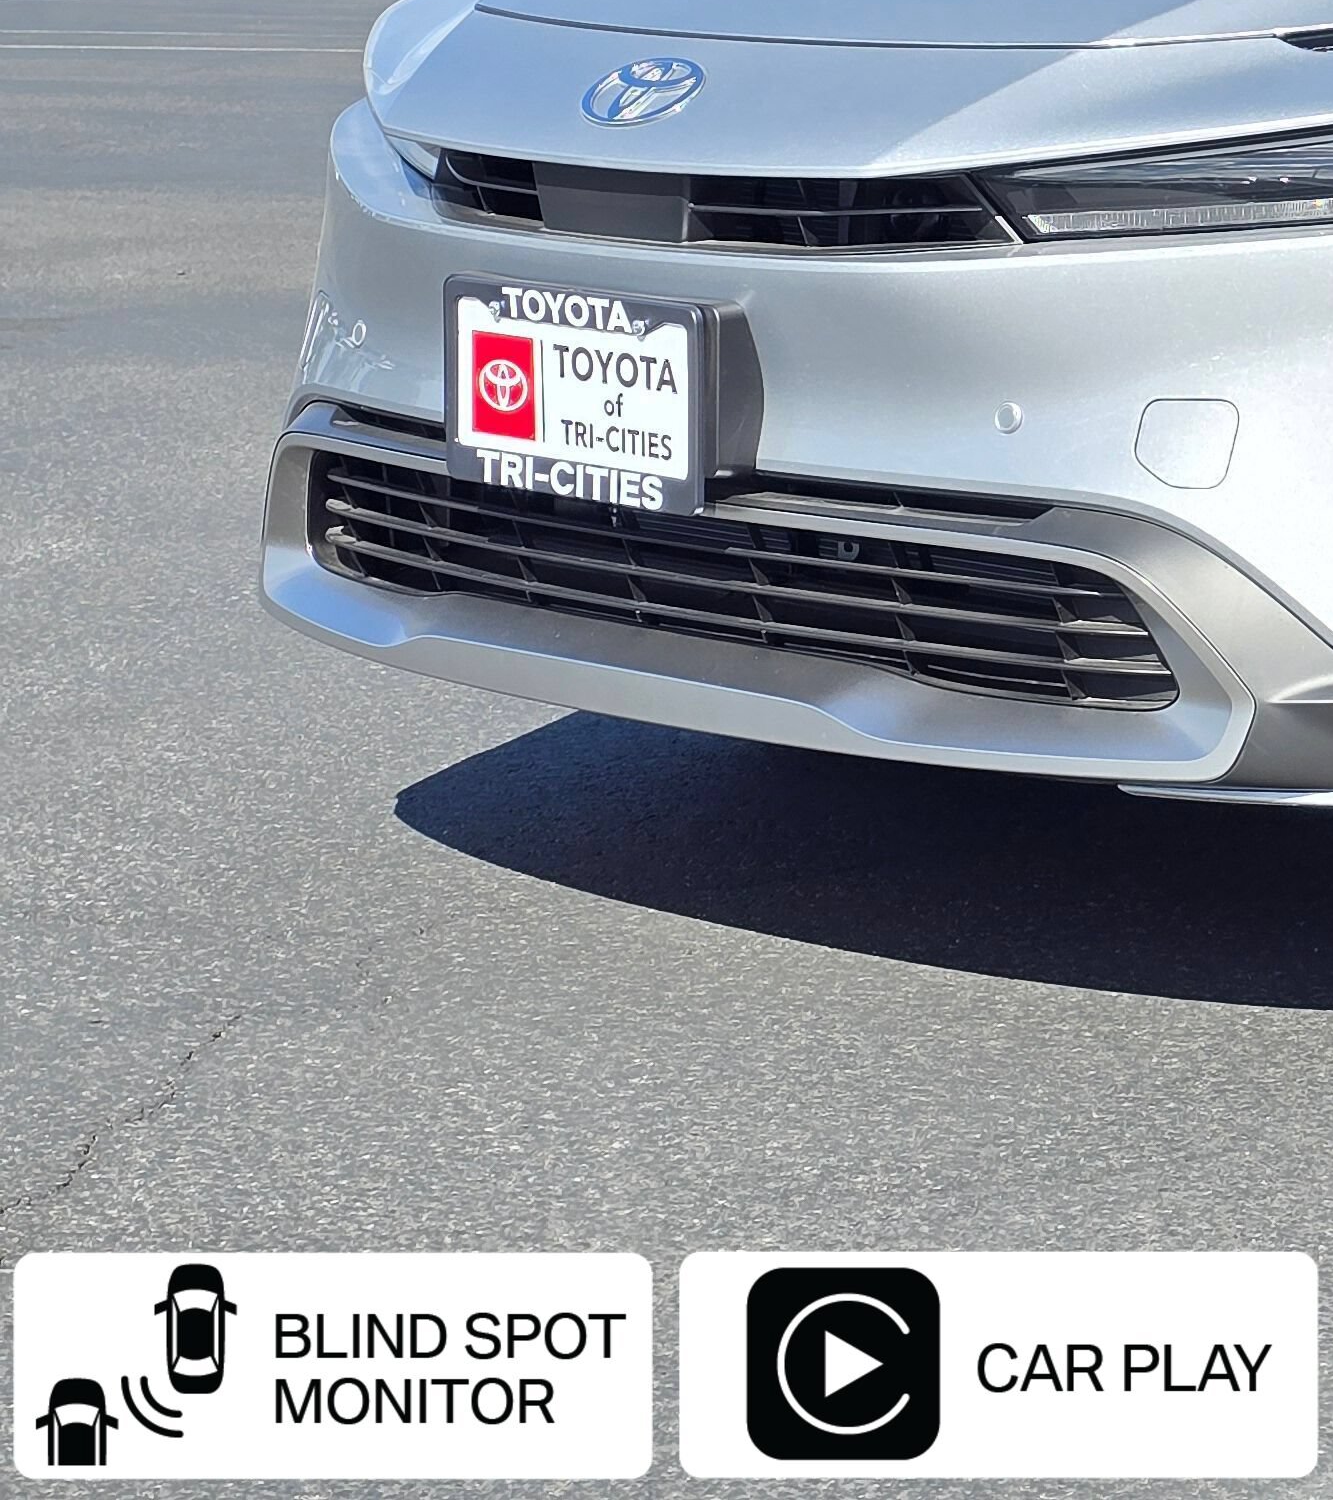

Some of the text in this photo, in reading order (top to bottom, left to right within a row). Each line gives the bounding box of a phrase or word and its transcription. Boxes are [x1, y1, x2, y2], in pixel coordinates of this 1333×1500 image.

[501, 286, 633, 334] TOYOTA
[553, 344, 678, 394] TOYOTA
[603, 392, 625, 418] of
[560, 419, 673, 462] TRI-CITIES
[476, 449, 664, 512] TRI-CITIES
